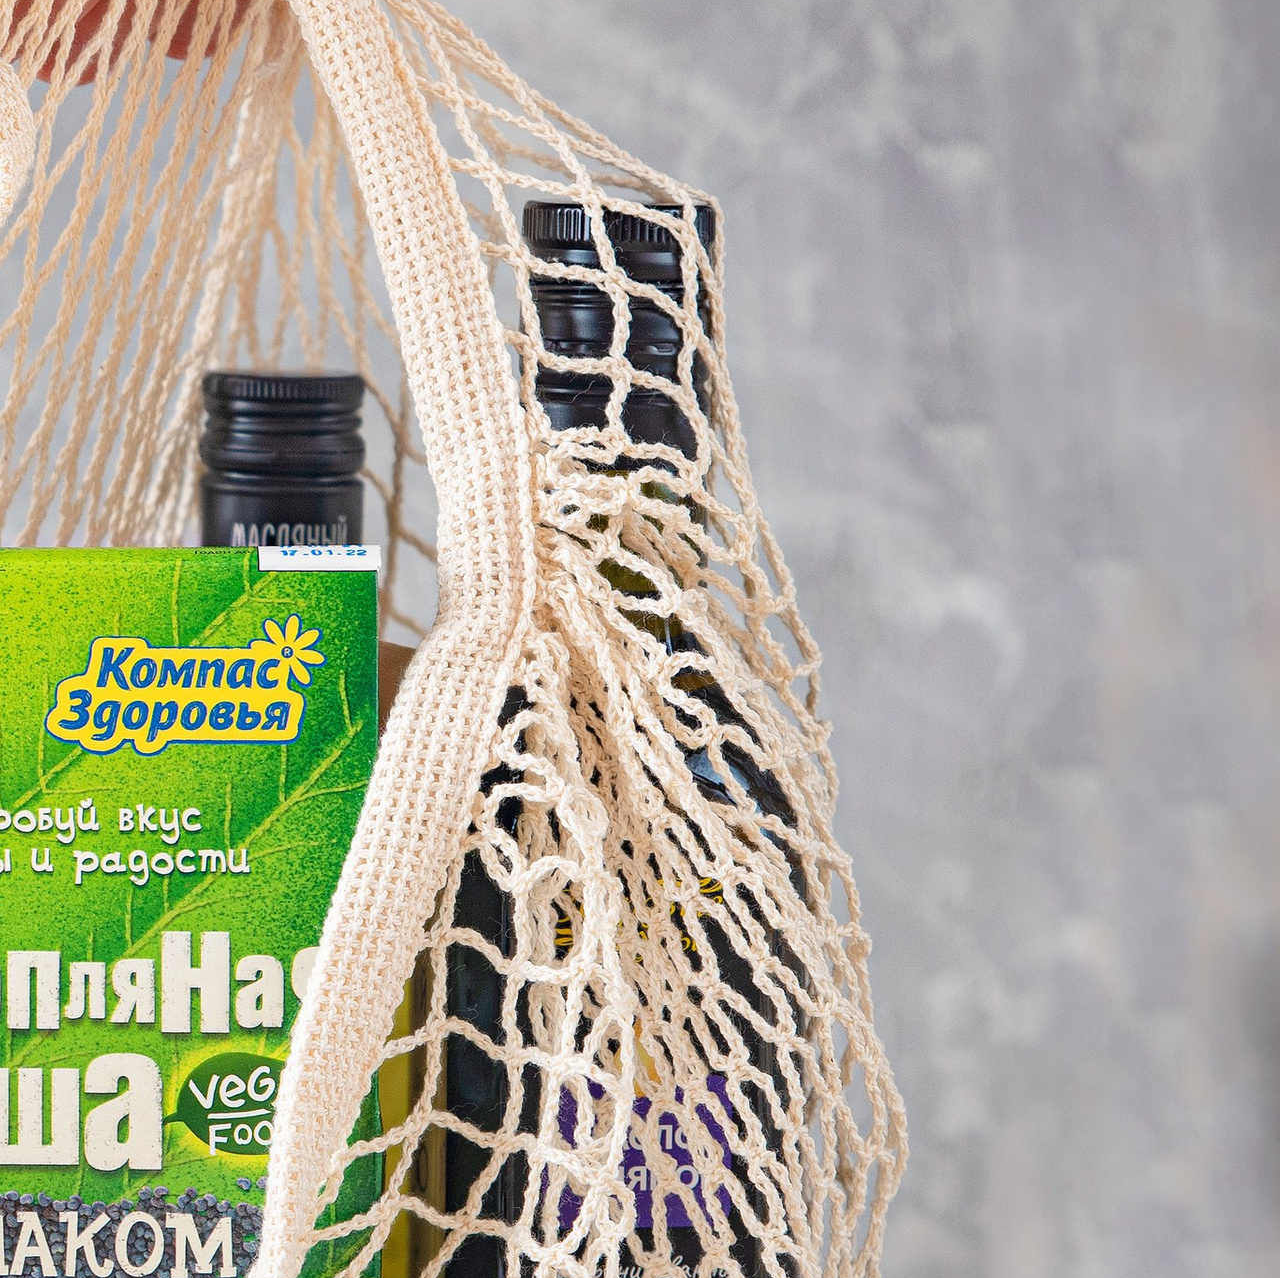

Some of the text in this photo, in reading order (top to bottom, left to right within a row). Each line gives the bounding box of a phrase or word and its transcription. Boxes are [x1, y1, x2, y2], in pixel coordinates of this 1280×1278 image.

[96, 645, 281, 690] Компас
[57, 688, 289, 742] Здоровья
[118, 805, 202, 847] вкус
[30, 849, 54, 873] и
[72, 845, 252, 888] радости
